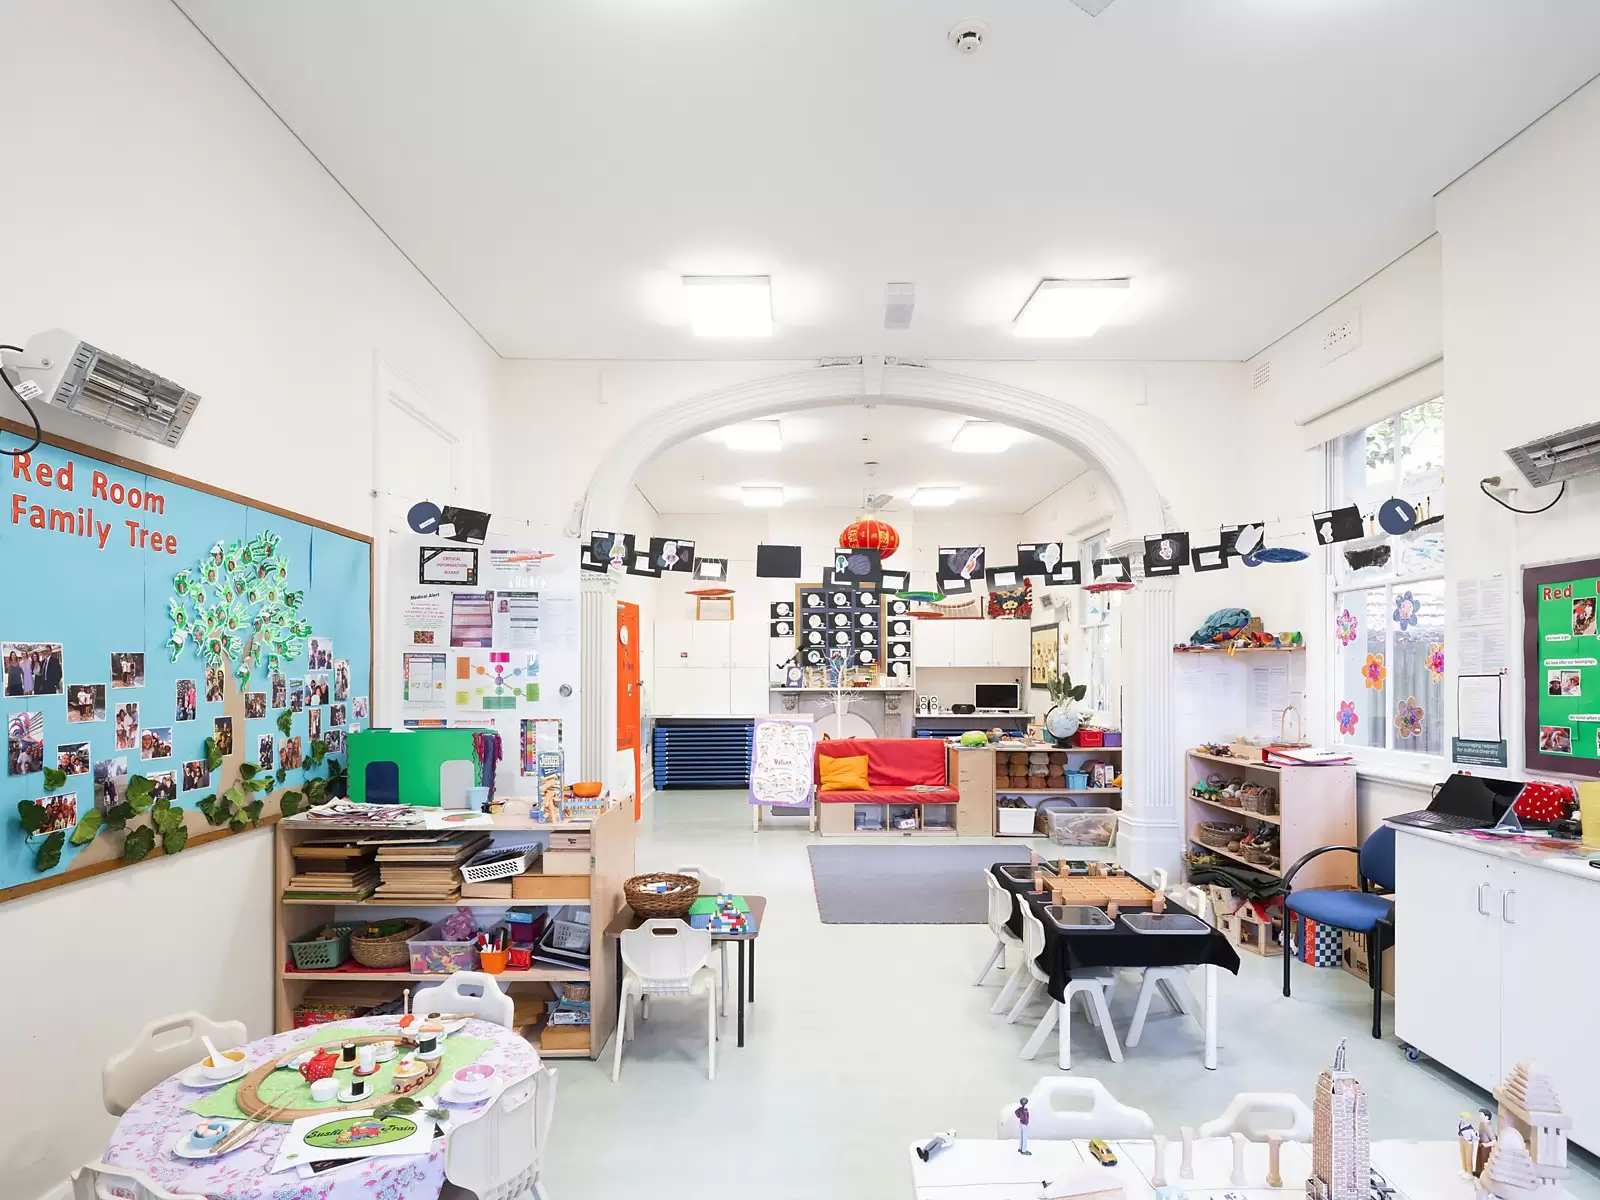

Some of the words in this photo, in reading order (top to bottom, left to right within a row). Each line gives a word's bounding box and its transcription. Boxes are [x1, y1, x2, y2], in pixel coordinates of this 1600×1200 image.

[12, 448, 74, 492] Red
[91, 470, 165, 515] Room
[11, 493, 112, 550] Family
[125, 520, 178, 554] Tree
[1543, 584, 1572, 600] Red
[539, 754, 560, 766] Jenga
[306, 1129, 343, 1139] Sushi
[381, 1124, 415, 1132] Train
